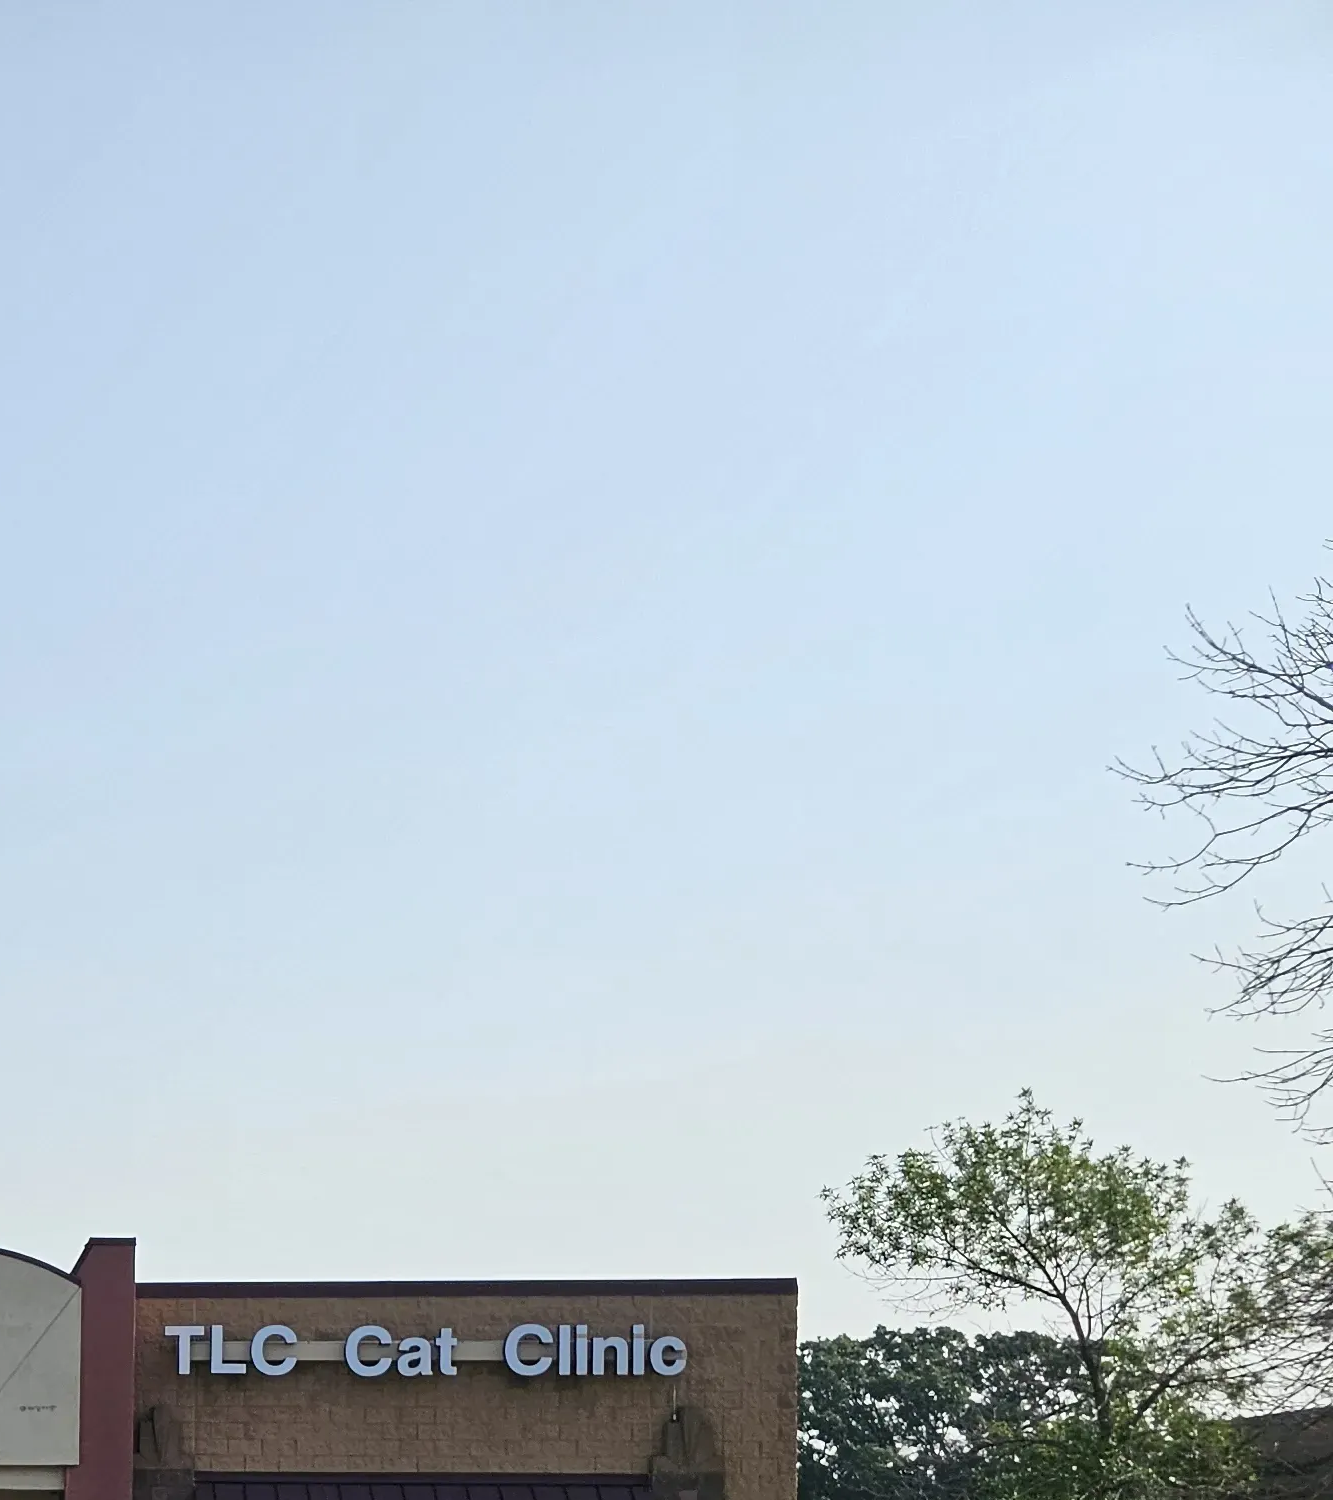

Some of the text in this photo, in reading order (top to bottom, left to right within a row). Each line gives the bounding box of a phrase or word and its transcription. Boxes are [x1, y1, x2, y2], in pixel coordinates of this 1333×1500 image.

[164, 1323, 688, 1377] TLC Cat Clinic
